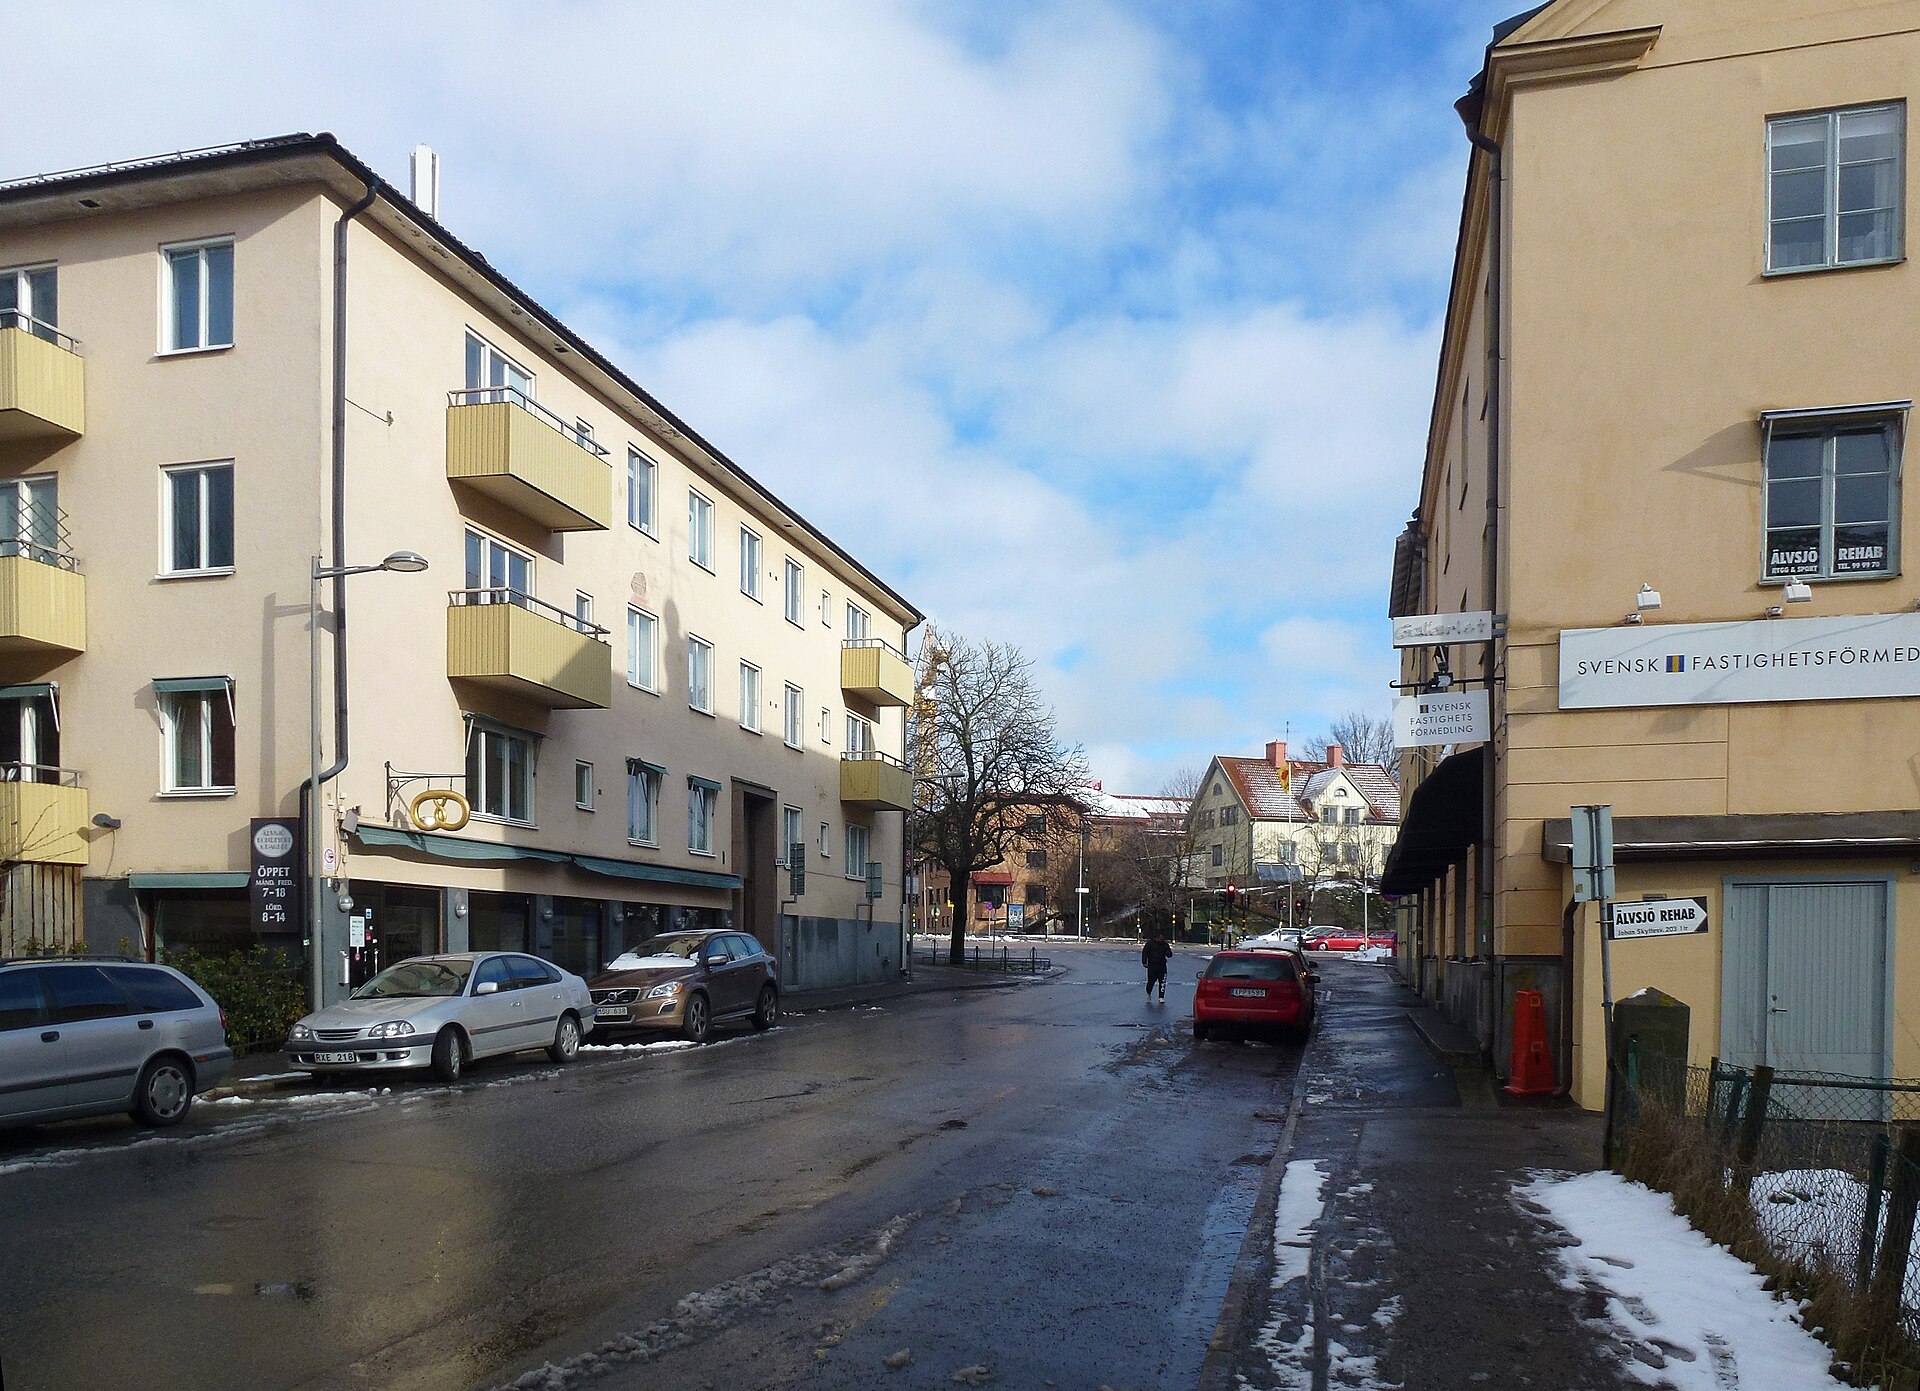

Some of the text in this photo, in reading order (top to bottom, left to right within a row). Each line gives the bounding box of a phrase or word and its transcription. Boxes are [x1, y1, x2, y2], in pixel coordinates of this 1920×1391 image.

[1771, 546, 1883, 565] ÄLVSJÖ REHAB
[1577, 658, 1659, 675] SVENSK
[1432, 702, 1471, 712] SVENSK
[1410, 714, 1472, 725] FASTIGHETS
[1411, 725, 1473, 737] FÖRMEDLING
[258, 865, 290, 877] ÖPPET
[262, 887, 286, 897] 7-18
[262, 912, 286, 922] 8-14
[1616, 907, 1695, 925] ÄLVSJÖ REHAB
[315, 1053, 353, 1062] RXE 218
